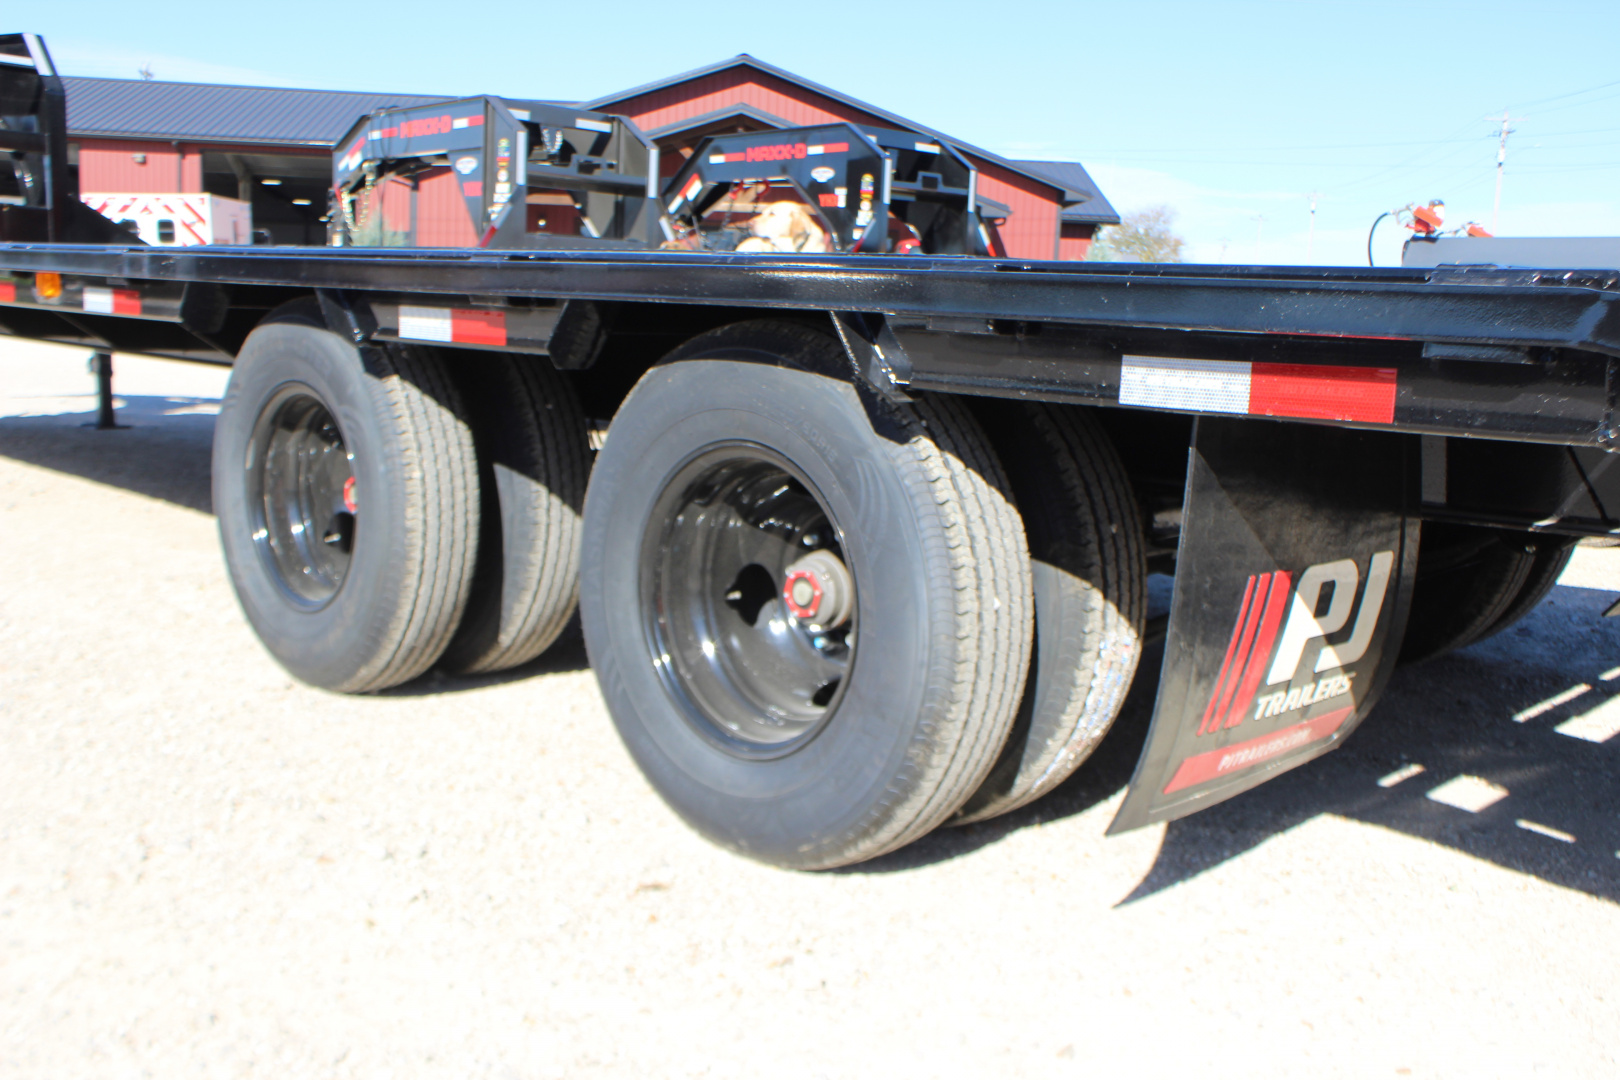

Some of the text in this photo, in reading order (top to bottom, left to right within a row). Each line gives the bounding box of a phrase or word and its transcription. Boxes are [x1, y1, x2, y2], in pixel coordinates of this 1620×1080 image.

[746, 142, 807, 163] MAXX-D
[1266, 549, 1395, 687] PJ
[1254, 675, 1353, 721] TRAILERS
